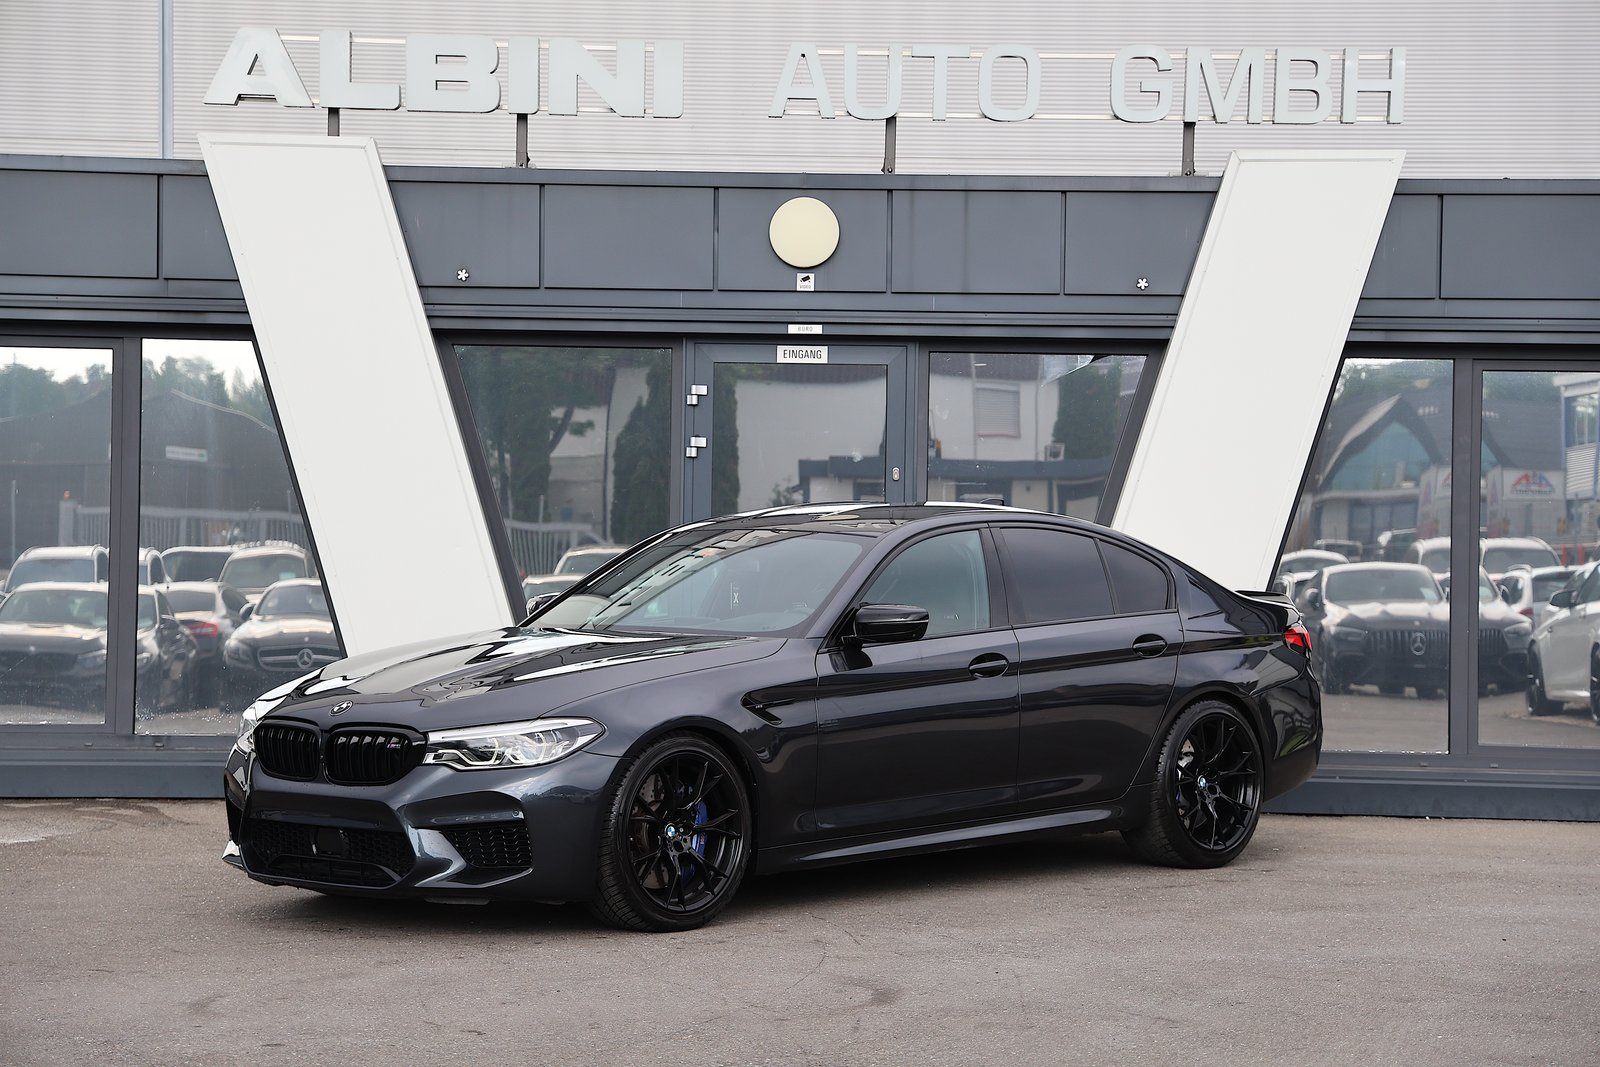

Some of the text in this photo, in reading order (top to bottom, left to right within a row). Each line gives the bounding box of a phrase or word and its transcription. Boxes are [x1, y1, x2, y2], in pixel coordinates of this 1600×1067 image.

[202, 27, 1406, 125] ALBINI AUTO GMBH
[783, 349, 822, 359] EINGANG
